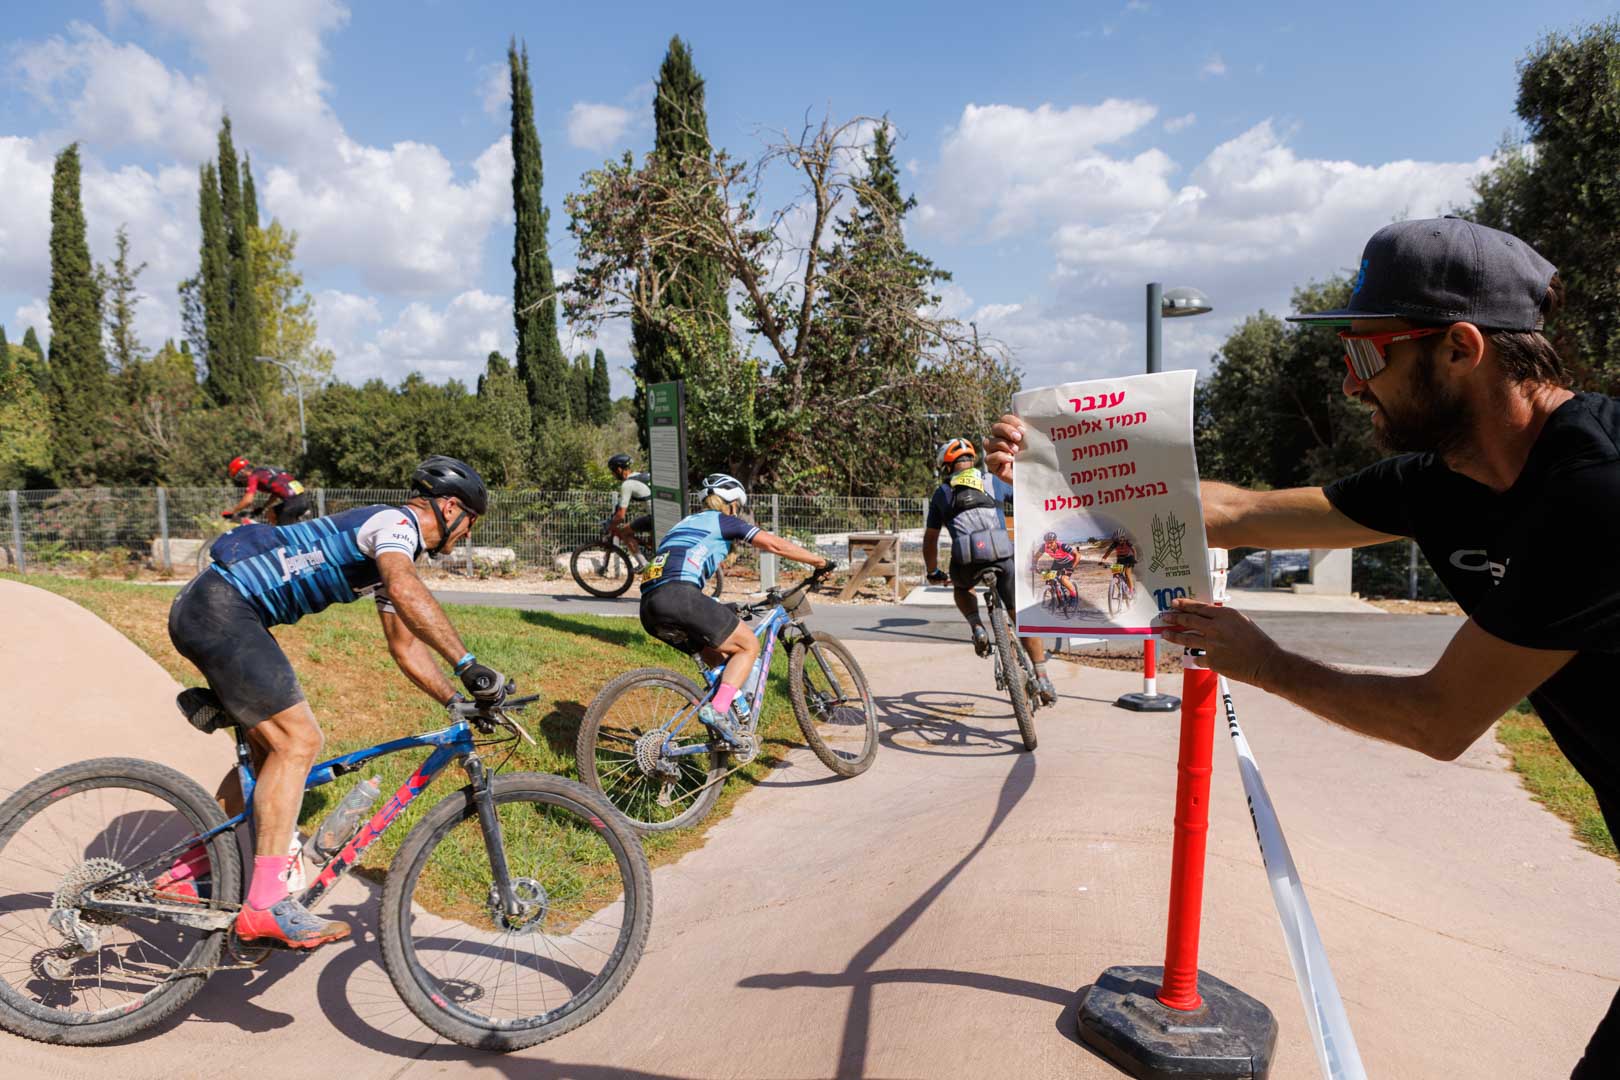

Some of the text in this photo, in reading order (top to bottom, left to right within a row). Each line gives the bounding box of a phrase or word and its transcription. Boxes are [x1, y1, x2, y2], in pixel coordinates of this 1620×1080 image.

[1068, 391, 1125, 413] ענבר
[1051, 411, 1147, 441] תמיד אלופה!
[1072, 439, 1128, 461] תותחית
[1071, 462, 1136, 485] ומדהימה
[1044, 482, 1168, 512] בהצלחה! מכולנו
